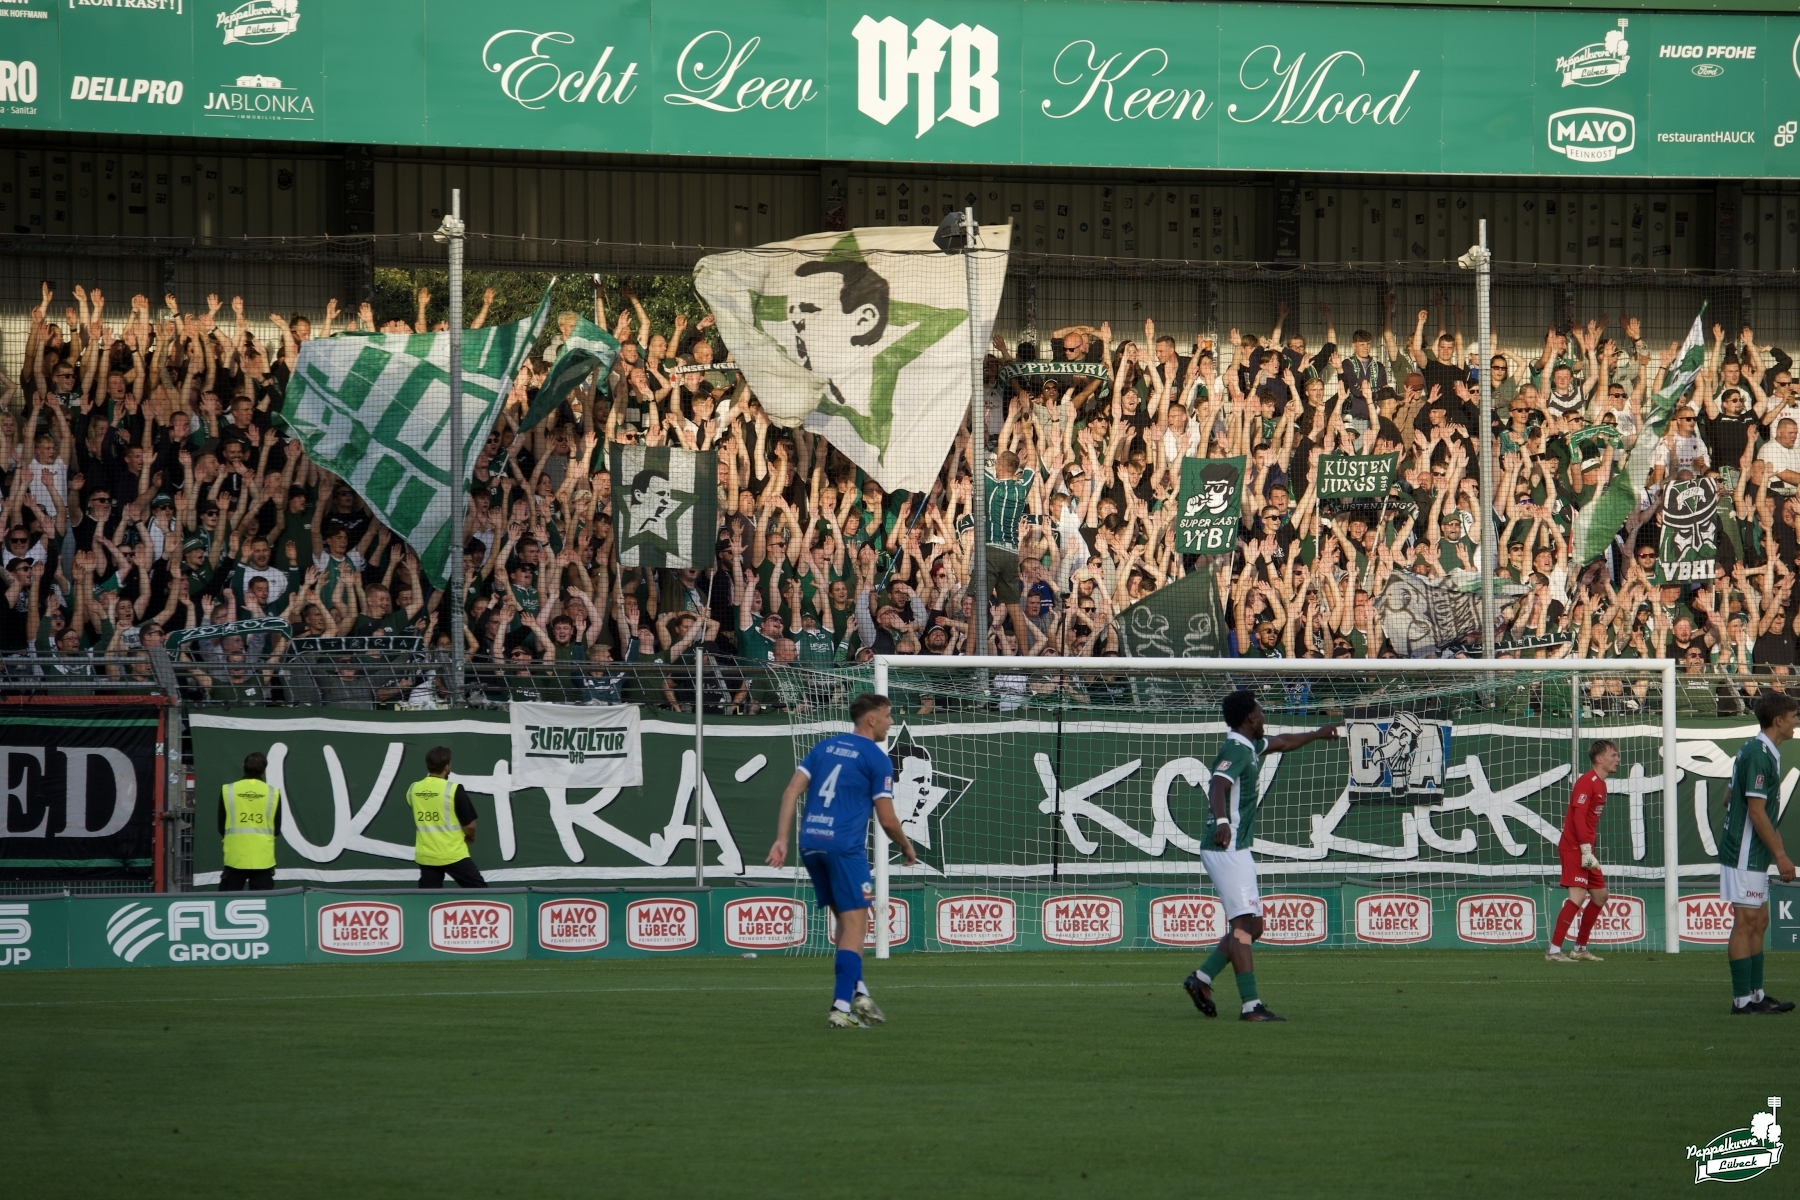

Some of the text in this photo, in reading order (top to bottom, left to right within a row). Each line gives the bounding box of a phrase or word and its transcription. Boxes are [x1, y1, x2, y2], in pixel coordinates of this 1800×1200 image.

[10, 10, 48, 19] HOFFMANN
[244, 23, 278, 36] Lübeck
[1556, 47, 1611, 72] Pappelkurve
[1659, 45, 1757, 59] HUGO PFOHE
[482, 29, 818, 113] Echt Leev
[851, 14, 1000, 140] VfB
[1581, 66, 1609, 78] Lübeck
[1697, 66, 1718, 76] Ford
[1041, 39, 1421, 125] Keen Mood
[70, 75, 184, 105] DELLPRO
[11, 106, 38, 115] Sanitär
[204, 92, 315, 114] JABLONKA
[1557, 120, 1627, 143] MAYO
[1657, 131, 1756, 144] restaurantHAUCK
[1570, 149, 1613, 159] FEINKOST
[1000, 361, 1109, 381] PAPPELKURV
[1324, 458, 1393, 477] KÜSTEN
[1321, 476, 1376, 493] JUNGS
[1380, 476, 1388, 492] 1919
[1682, 487, 1700, 498] 1919
[1180, 516, 1239, 528] SUPER EASY
[818, 764, 842, 808] 4
[240, 812, 264, 824] 243
[418, 811, 440, 822] 288
[443, 908, 500, 926] MAYO
[550, 907, 596, 924] MAYO
[638, 906, 686, 923] MAYO
[738, 906, 794, 922] MAYO
[950, 904, 1004, 920] MAYO
[1055, 903, 1110, 919] MAYO
[1162, 902, 1216, 918] MAYO
[1262, 902, 1315, 918] MAYO
[1368, 902, 1420, 917] MAYO
[1470, 902, 1524, 918] MAYO
[1576, 902, 1632, 918] AYO
[1779, 900, 1794, 920] K
[168, 898, 270, 942] FLS
[333, 910, 390, 927] MAYO
[950, 920, 1002, 932] LÜBECK
[1056, 920, 1110, 932] LÜBECK
[1163, 919, 1216, 932] LÜBECK
[1263, 919, 1314, 932] LÜBECK
[1368, 918, 1419, 930] LÜBECK
[1470, 918, 1523, 930] LÜBECK
[1577, 918, 1632, 931] LBECK
[1686, 918, 1734, 931] LÜBEC
[333, 927, 388, 940] LÜBECK
[444, 926, 498, 940] LÜBECK
[550, 924, 596, 938] LÜBECK
[638, 924, 686, 937] LÜBECK
[738, 922, 793, 936] LÜBECK
[168, 942, 270, 962] GROUP
